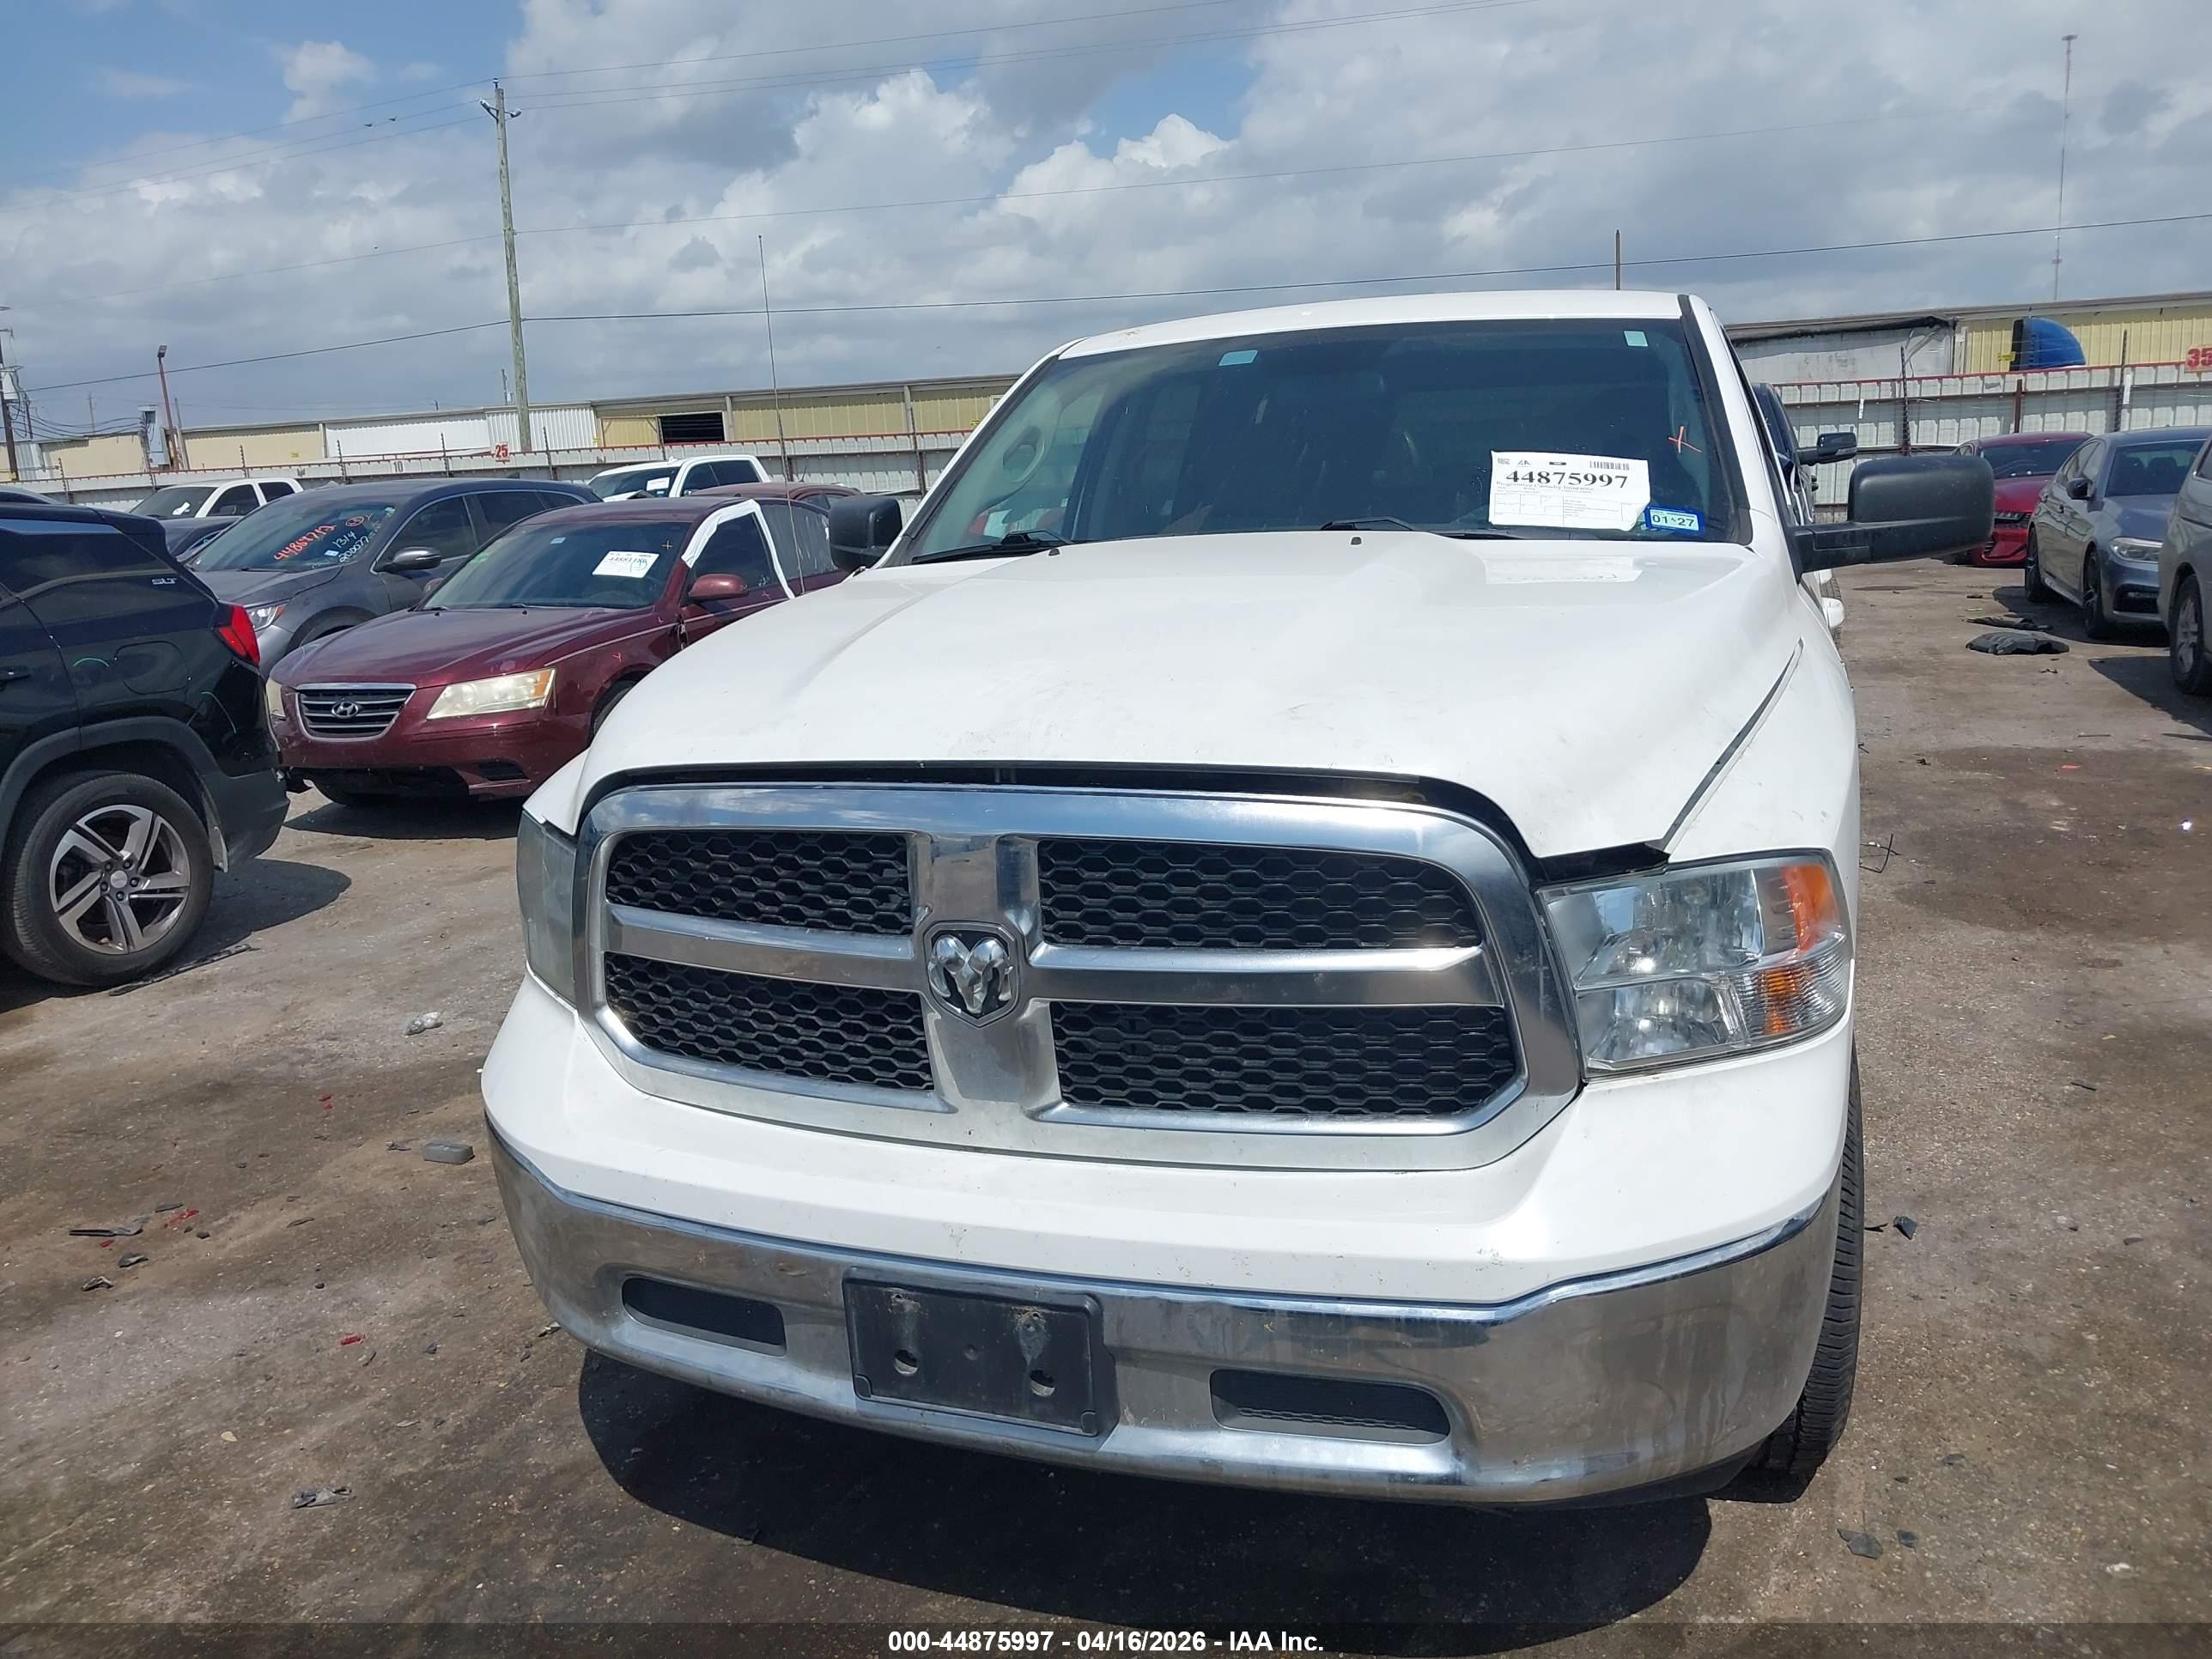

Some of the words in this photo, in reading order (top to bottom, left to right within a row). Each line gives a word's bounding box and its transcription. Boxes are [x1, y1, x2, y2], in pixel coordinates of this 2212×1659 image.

[2187, 347, 2212, 368] 35
[495, 445, 508, 458] 25
[393, 460, 404, 472] 10
[1505, 470, 1628, 489] 44875997
[1652, 514, 1668, 524] 01
[1677, 517, 1694, 526] 27
